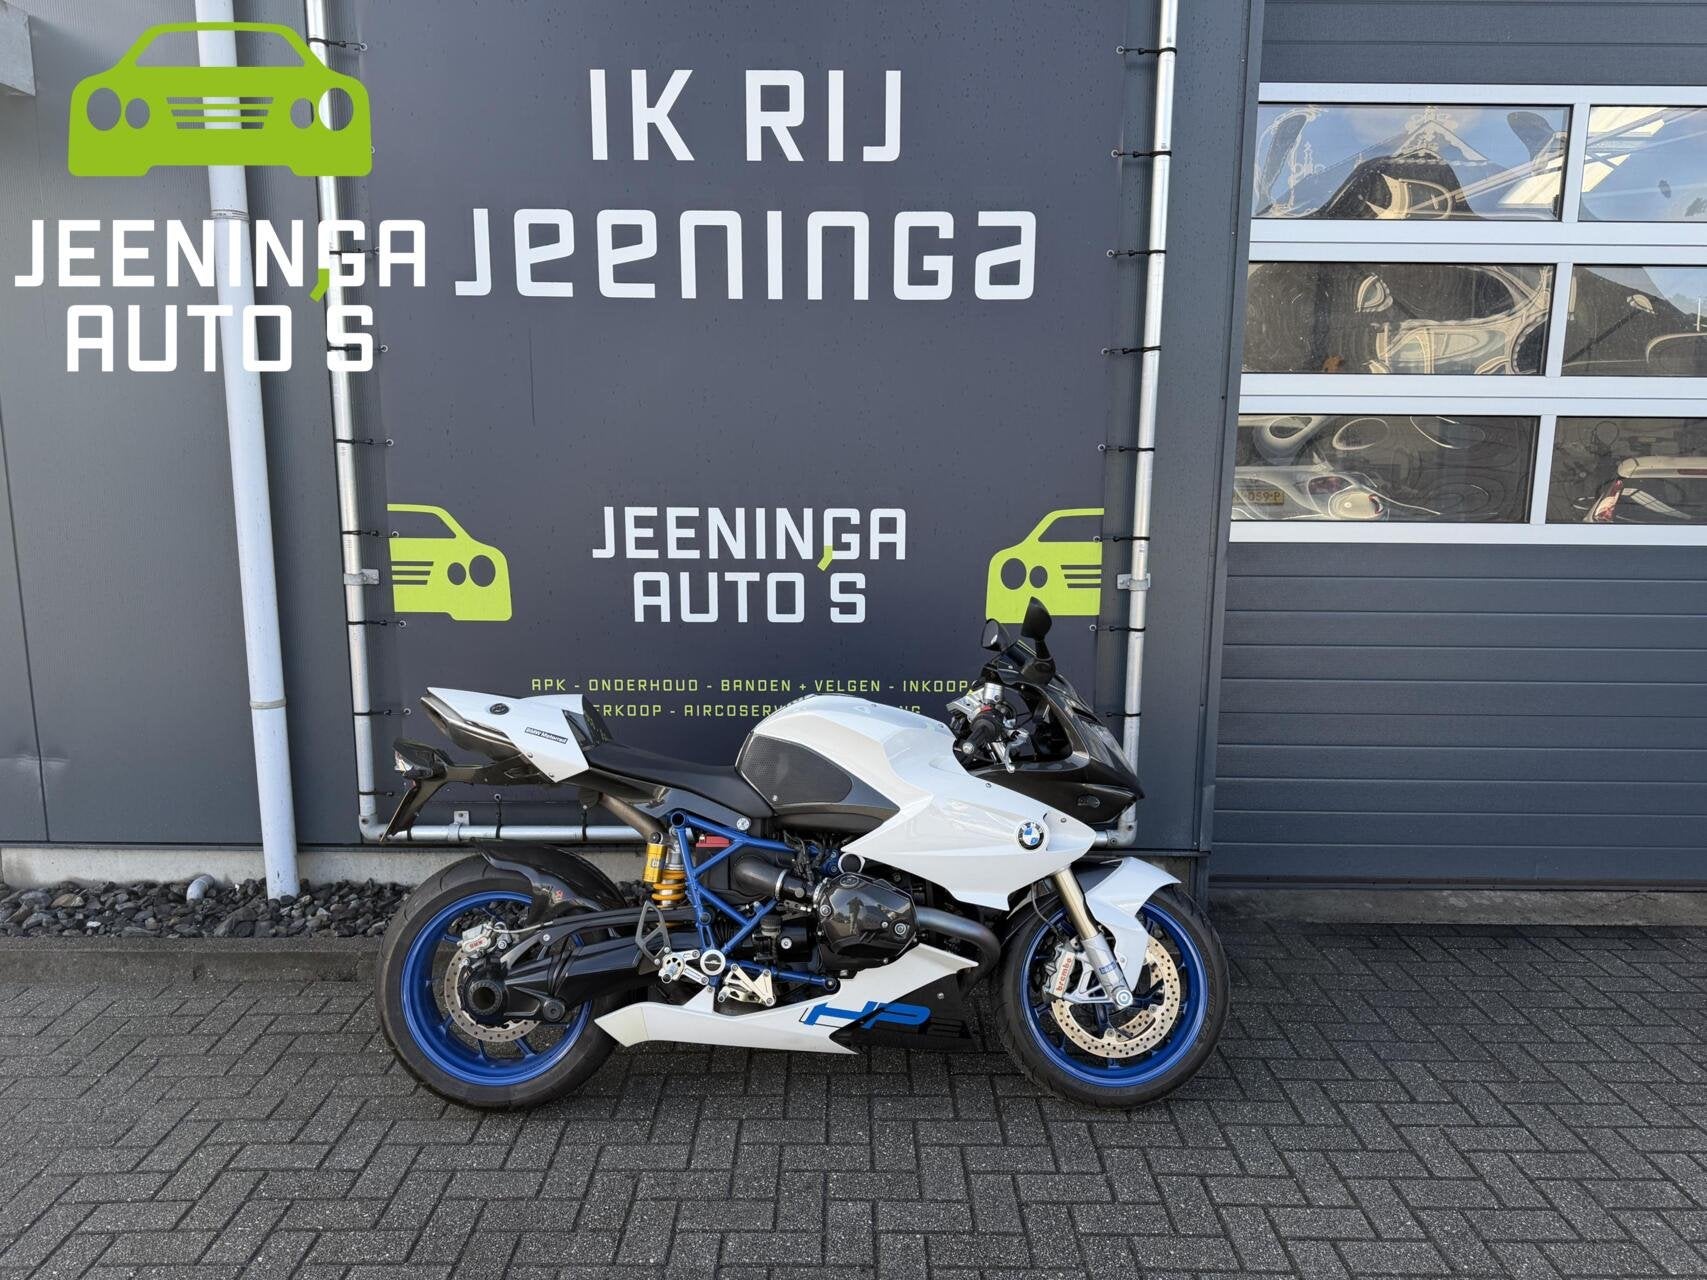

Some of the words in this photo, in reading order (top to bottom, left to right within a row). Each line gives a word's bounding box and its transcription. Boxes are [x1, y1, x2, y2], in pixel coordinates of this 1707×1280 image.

[589, 69, 695, 161] IK
[745, 69, 901, 162] RIJ
[592, 506, 906, 560] JEENINGA
[531, 679, 566, 691] APK
[588, 679, 698, 691] ONDERHOUD
[721, 679, 791, 692] BANDEN
[814, 680, 881, 692] VELGEN
[903, 680, 969, 692] INKOOP
[1056, 958, 1072, 991] brembo
